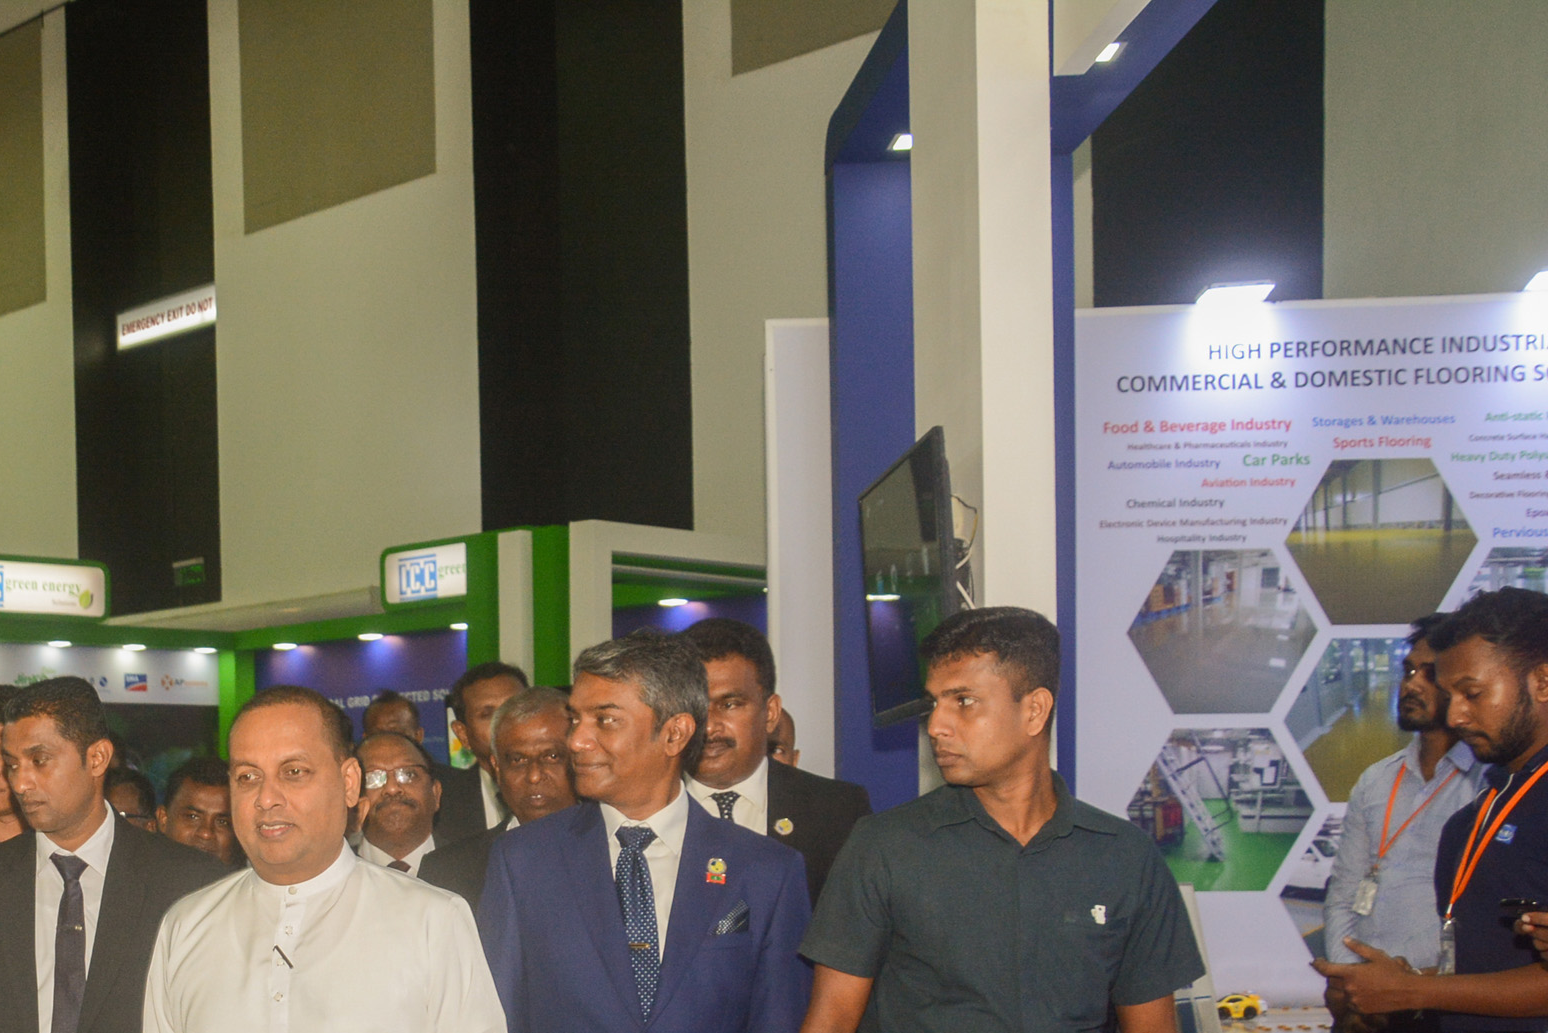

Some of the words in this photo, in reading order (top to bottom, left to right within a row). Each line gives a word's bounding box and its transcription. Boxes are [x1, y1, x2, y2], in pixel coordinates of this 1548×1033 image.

[122, 312, 165, 336] EMERGENCY
[167, 306, 184, 322] EXIT
[186, 302, 196, 316] DO
[197, 297, 213, 312] NOT
[1209, 342, 1261, 360] HIGH
[1270, 336, 1434, 359] PERFORMANCE
[1442, 334, 1548, 355] INDUSTRI
[1116, 373, 1264, 393] COMMERCIAL
[1270, 371, 1286, 389] &
[1295, 368, 1407, 388] DOMESTIC
[1414, 364, 1526, 386] FLOORING
[1103, 420, 1139, 434] Food
[1143, 420, 1155, 433] &
[1159, 420, 1227, 434] Beverage
[1231, 417, 1292, 434] Industry
[1312, 416, 1364, 428] Storages
[1367, 415, 1377, 426] &
[1380, 414, 1456, 426] Warehouses
[1333, 437, 1375, 450] Sports
[1378, 435, 1432, 449] Flooring
[1107, 459, 1173, 470] Automobile
[1175, 458, 1221, 469] Industry
[1242, 454, 1267, 467] Car
[1271, 453, 1311, 467] Parks
[1201, 477, 1247, 488] Aviation
[1250, 477, 1296, 488] Industry
[1126, 498, 1176, 509] Chemical
[1179, 498, 1225, 509] Industry
